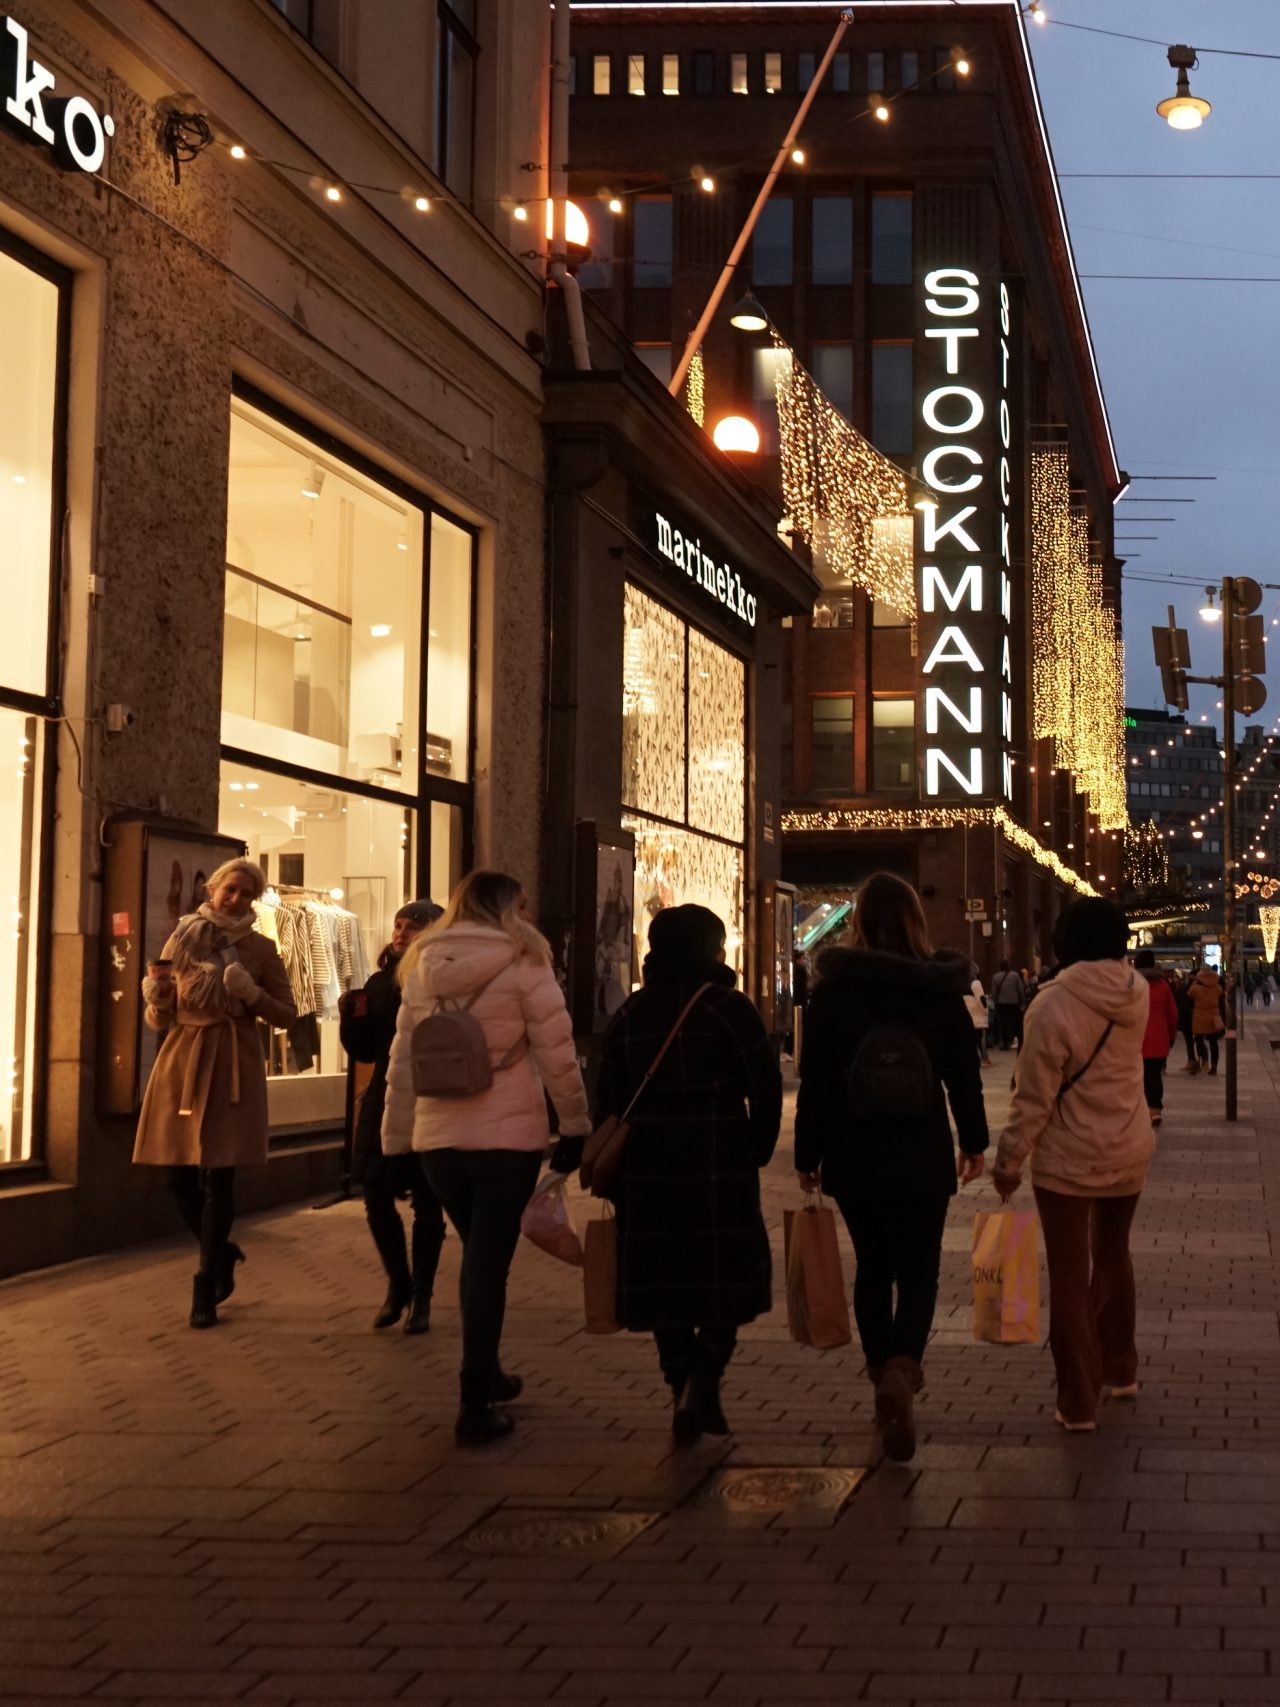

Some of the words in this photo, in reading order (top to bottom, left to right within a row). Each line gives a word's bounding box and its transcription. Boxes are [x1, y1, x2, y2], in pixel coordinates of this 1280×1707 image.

[656, 512, 757, 627] marimekko
[921, 268, 984, 796] STOCKMANN
[1000, 282, 1013, 802] STOCKMANN
